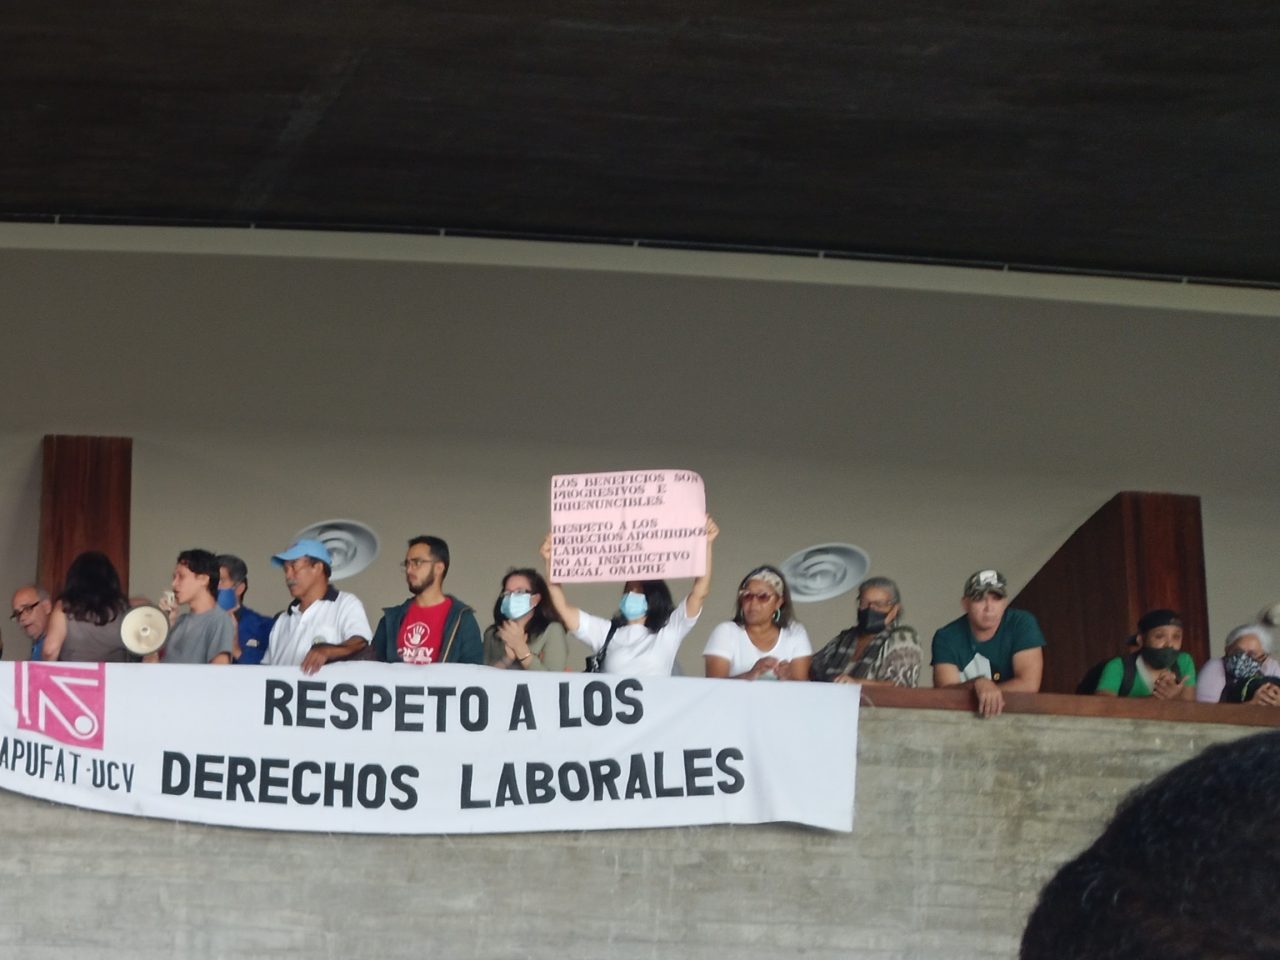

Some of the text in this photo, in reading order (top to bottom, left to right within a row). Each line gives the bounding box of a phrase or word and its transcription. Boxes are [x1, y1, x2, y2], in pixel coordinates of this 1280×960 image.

[553, 472, 699, 488] LOS BENEFICIOS SON
[657, 484, 667, 494] E
[553, 518, 658, 534] RESPETO A LOS
[553, 532, 625, 546] DERECHOS
[552, 557, 570, 567] NO
[573, 555, 591, 566] AL
[552, 566, 603, 577] ILEGAL
[263, 678, 644, 733] RESPETO A LOS
[161, 747, 745, 811] DERECHOS LABORALES
